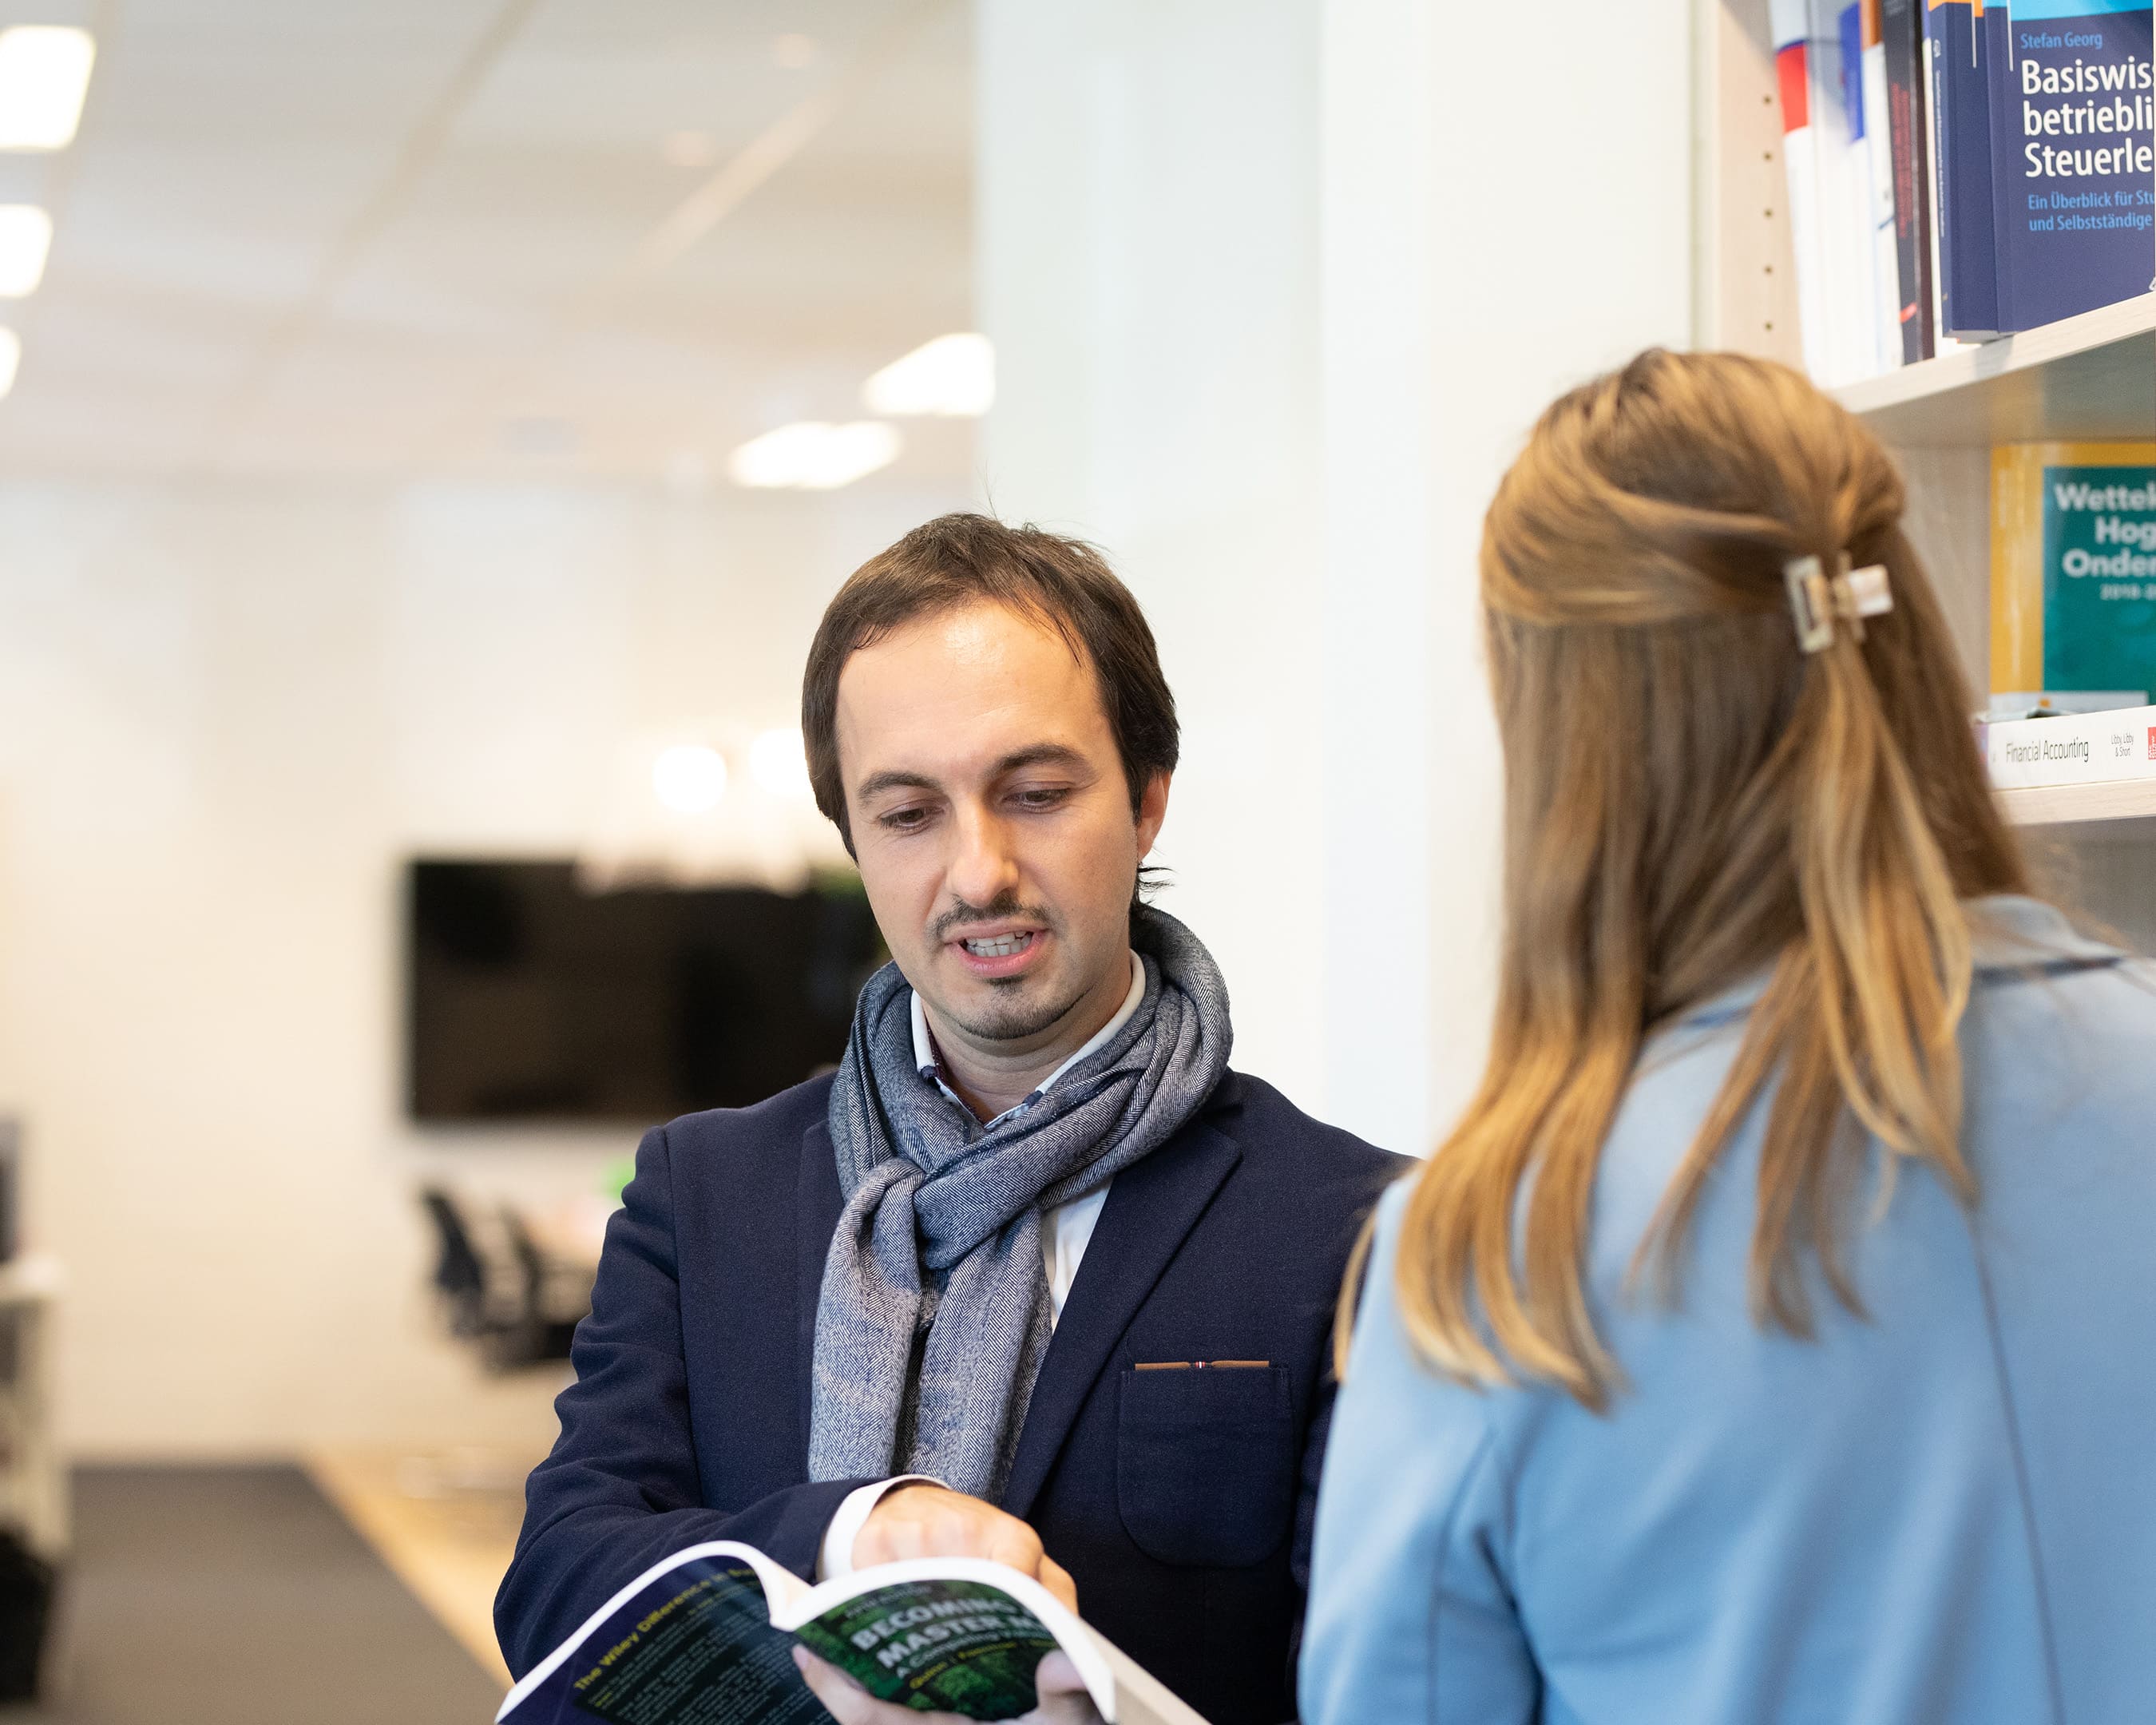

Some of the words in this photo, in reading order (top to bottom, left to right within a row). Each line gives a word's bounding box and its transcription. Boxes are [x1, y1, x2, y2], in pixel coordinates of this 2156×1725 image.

[2020, 33, 2062, 50] Stefan
[2064, 32, 2102, 50] Georg
[2021, 55, 2154, 95] Basiswis
[2023, 94, 2154, 136] betriebli
[2024, 137, 2153, 178] Steuerle
[2027, 193, 2047, 210] Ein
[2051, 191, 2111, 210] Überblick
[2114, 190, 2134, 206] für
[2029, 215, 2054, 232] und
[2056, 212, 2153, 231] Selbstständige
[2006, 740, 2041, 763] Financial
[2043, 736, 2089, 763] Accounting
[850, 1599, 1018, 1651] BECOMING
[876, 1615, 1006, 1669] MASTER
[600, 1632, 640, 1666] Wiley
